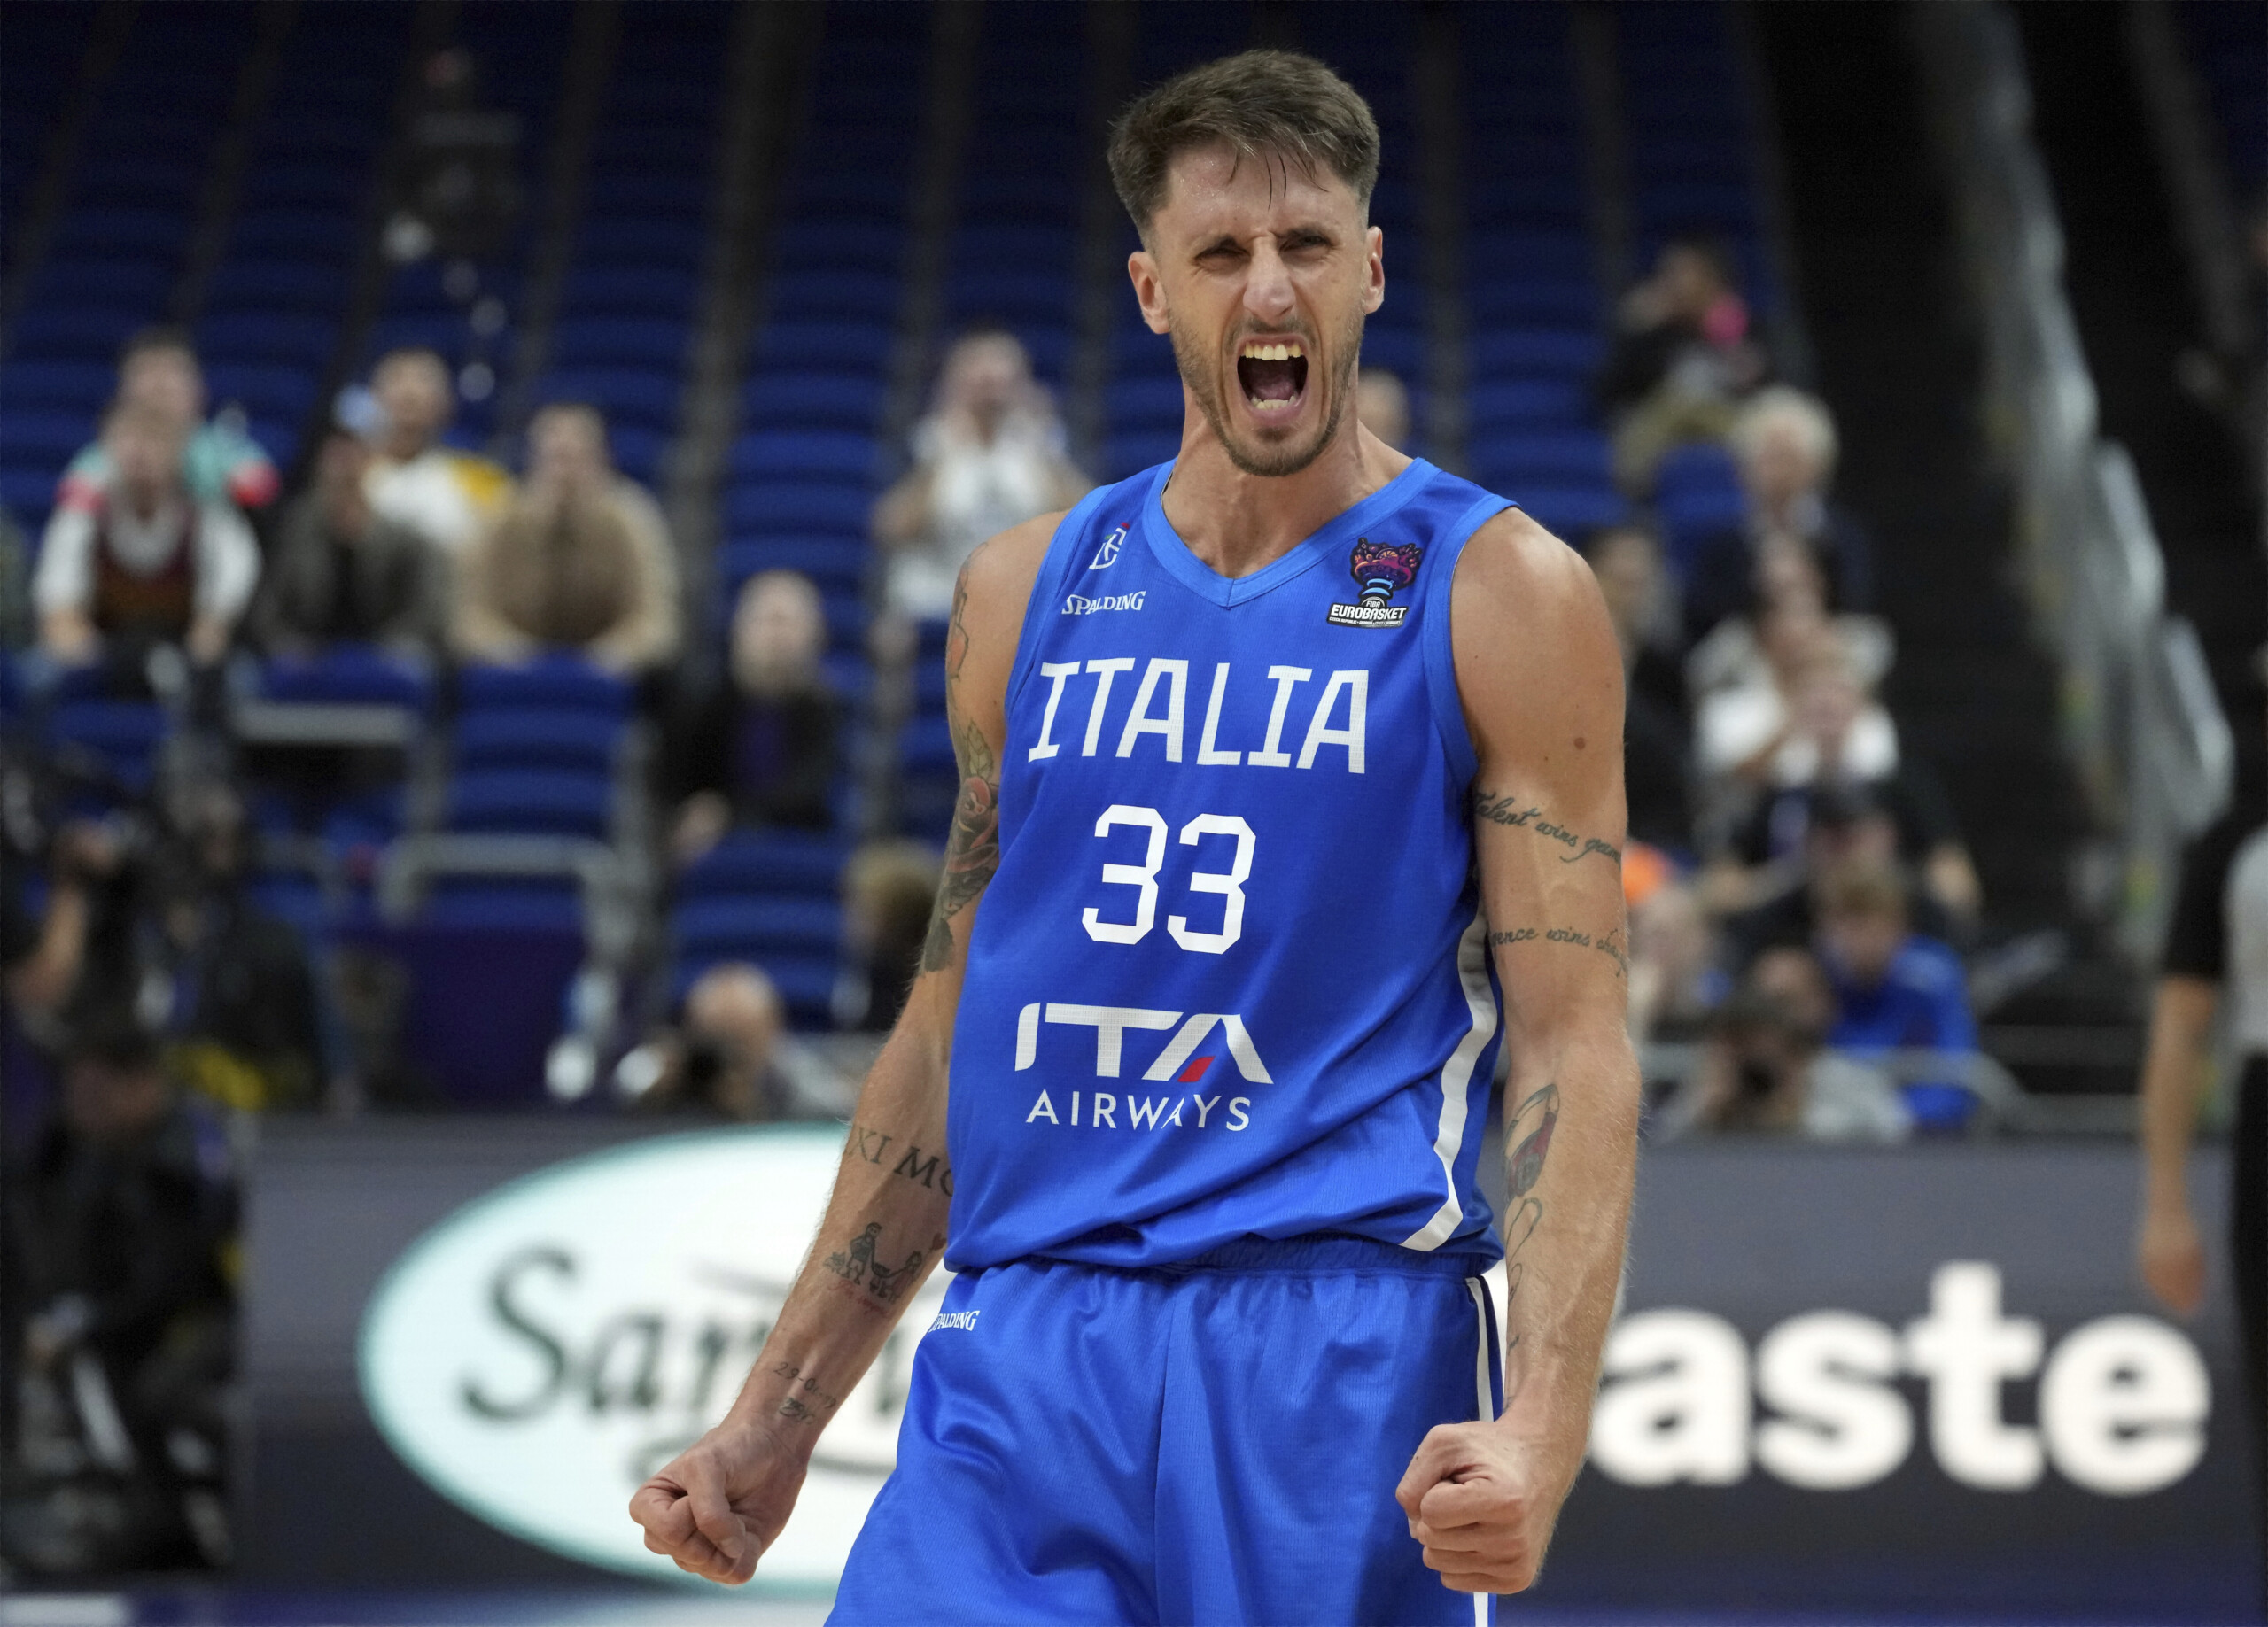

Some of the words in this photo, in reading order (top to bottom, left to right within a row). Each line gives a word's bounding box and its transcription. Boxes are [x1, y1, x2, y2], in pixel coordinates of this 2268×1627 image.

[1061, 591, 1146, 615] SPALDING
[1330, 604, 1407, 620] EUROBASKET
[1028, 658, 1369, 774] ITALIA
[1535, 825, 1579, 847] wins
[1081, 804, 1256, 954] 33
[1546, 926, 1591, 947] wins
[1014, 1002, 1274, 1084] ITA
[1025, 1089, 1251, 1132] AIRWAYS
[1591, 1260, 2213, 1496] aste
